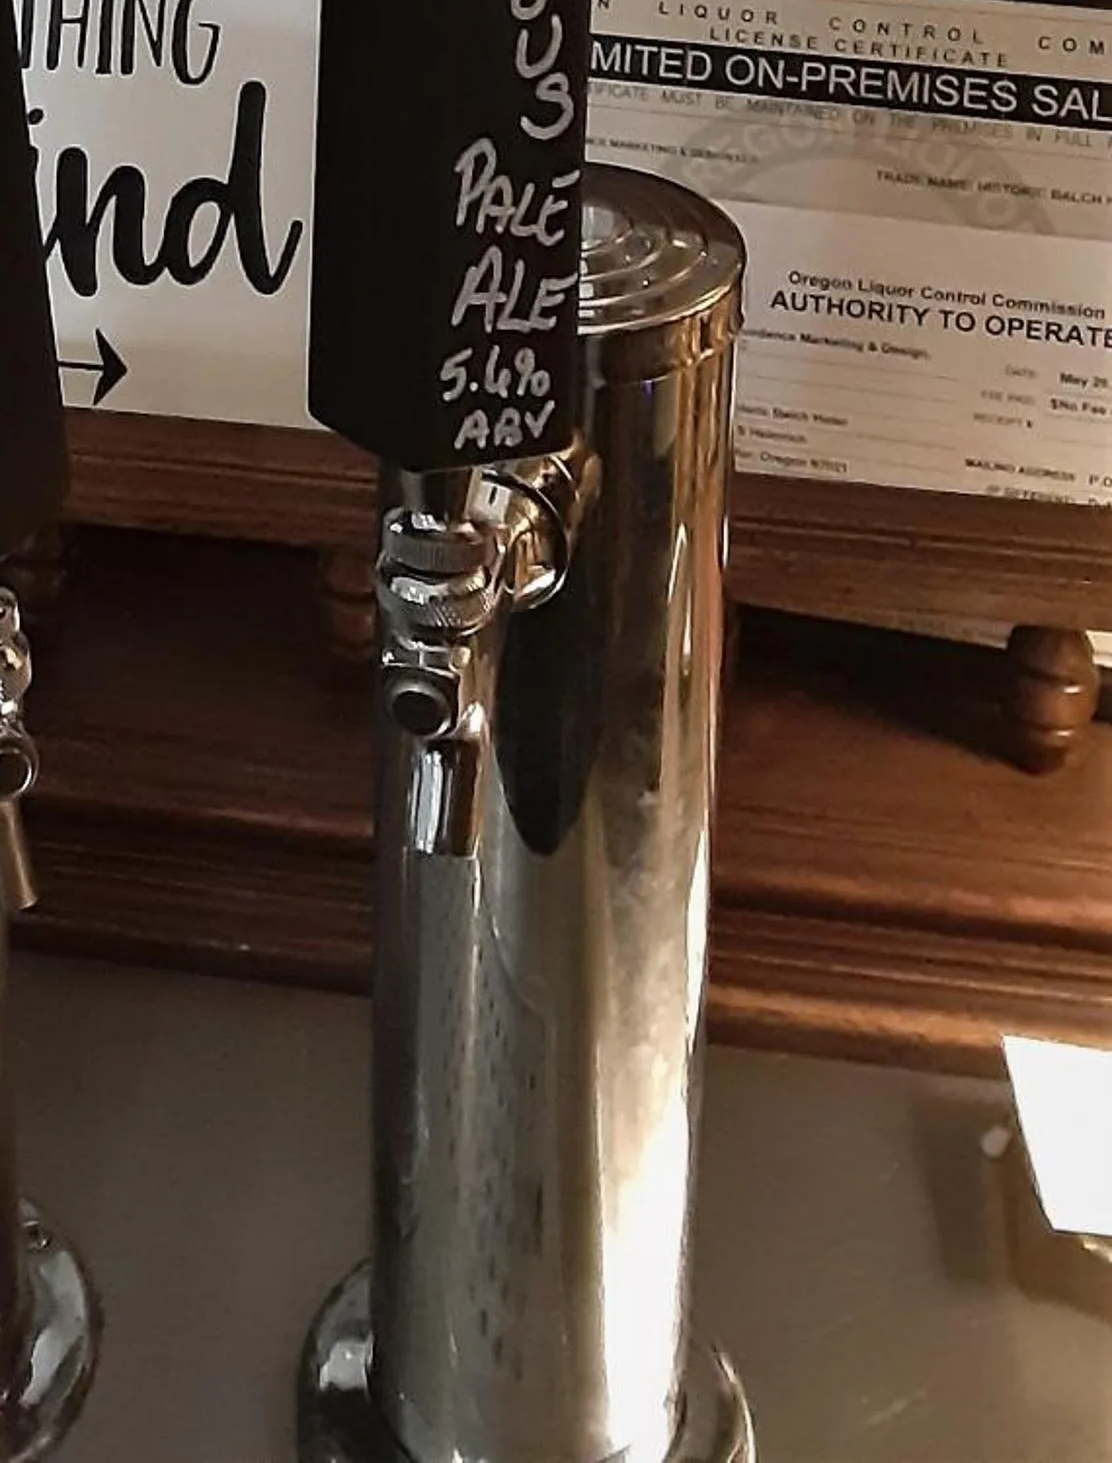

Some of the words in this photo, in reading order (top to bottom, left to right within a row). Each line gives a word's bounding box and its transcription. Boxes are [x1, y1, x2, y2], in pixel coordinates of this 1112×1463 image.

[659, 0, 778, 25] LIQUOR
[829, 17, 985, 45] CONTROL
[710, 27, 819, 50] LICENSE
[835, 38, 1009, 68] CERTIFICATE
[590, 40, 713, 82] MITED
[725, 54, 1018, 113] ON-PREMISES
[454, 138, 581, 247] PALE
[451, 245, 579, 335] ALE
[789, 270, 852, 291] Oregon
[858, 278, 915, 298] Liquor
[921, 286, 986, 306] Control
[992, 293, 1106, 320] Commission
[770, 290, 929, 327] AUTHORITY
[939, 309, 976, 333] TO
[985, 315, 1112, 349] OPERATE
[453, 399, 555, 451] ABV
